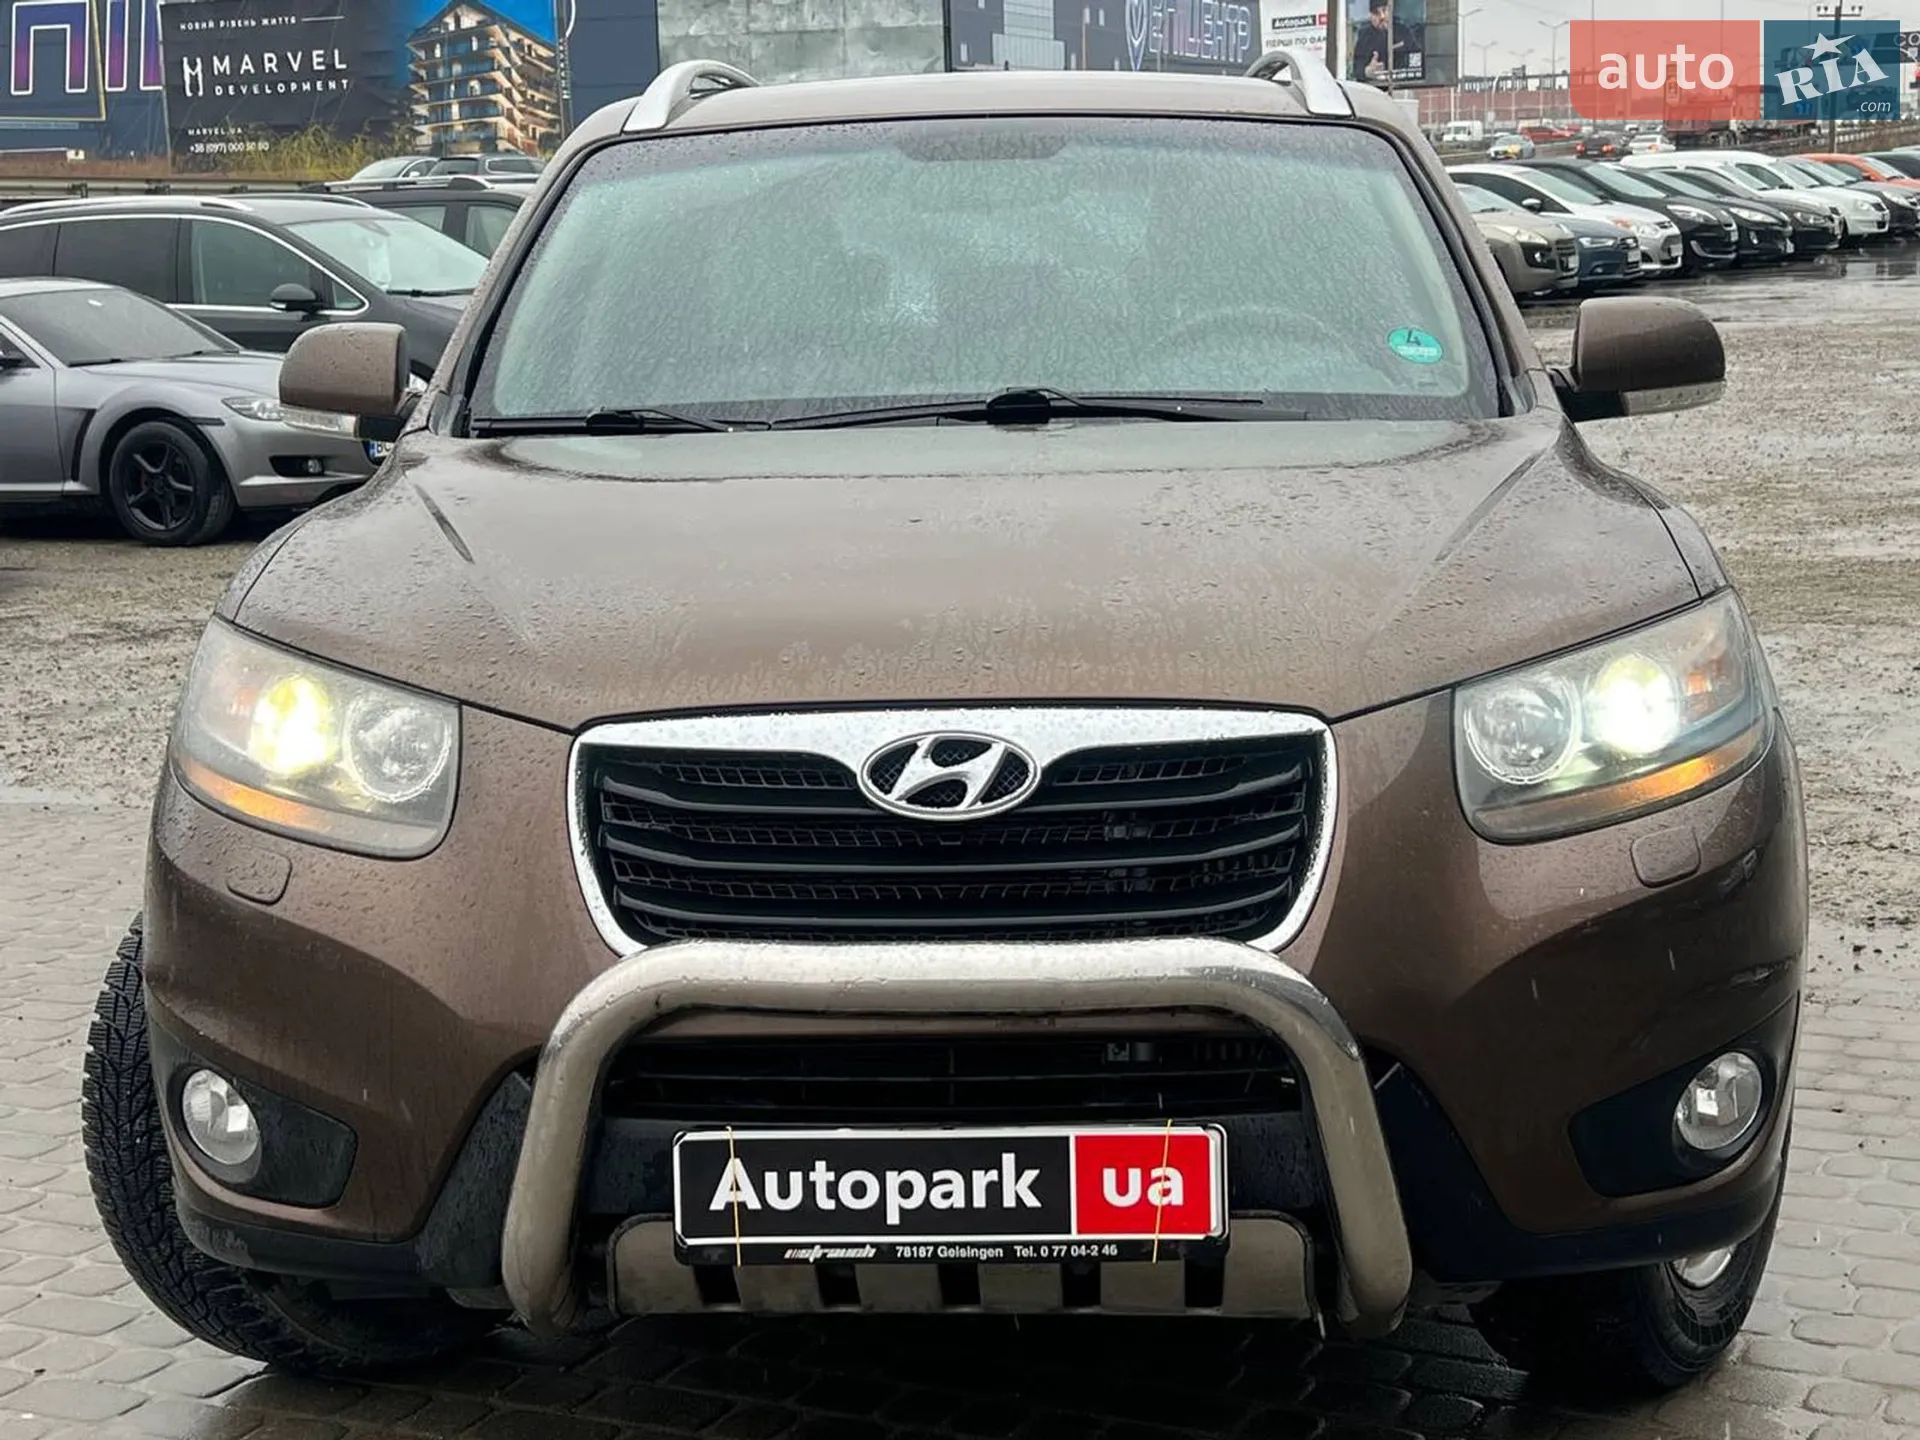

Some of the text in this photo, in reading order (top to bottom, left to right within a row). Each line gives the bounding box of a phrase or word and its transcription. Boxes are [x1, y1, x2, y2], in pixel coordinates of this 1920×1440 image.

[219, 18, 256, 28] РІВЕНЬ
[212, 48, 347, 76] MARVEL
[215, 79, 348, 96] DEVELOPMENT
[709, 1153, 1185, 1226] Autopark ua
[895, 1245, 935, 1258] 78187
[937, 1245, 1004, 1261] Geisingen
[1013, 1245, 1038, 1258] Tel.
[1039, 1245, 1050, 1258] 0
[1052, 1245, 1068, 1258] 77
